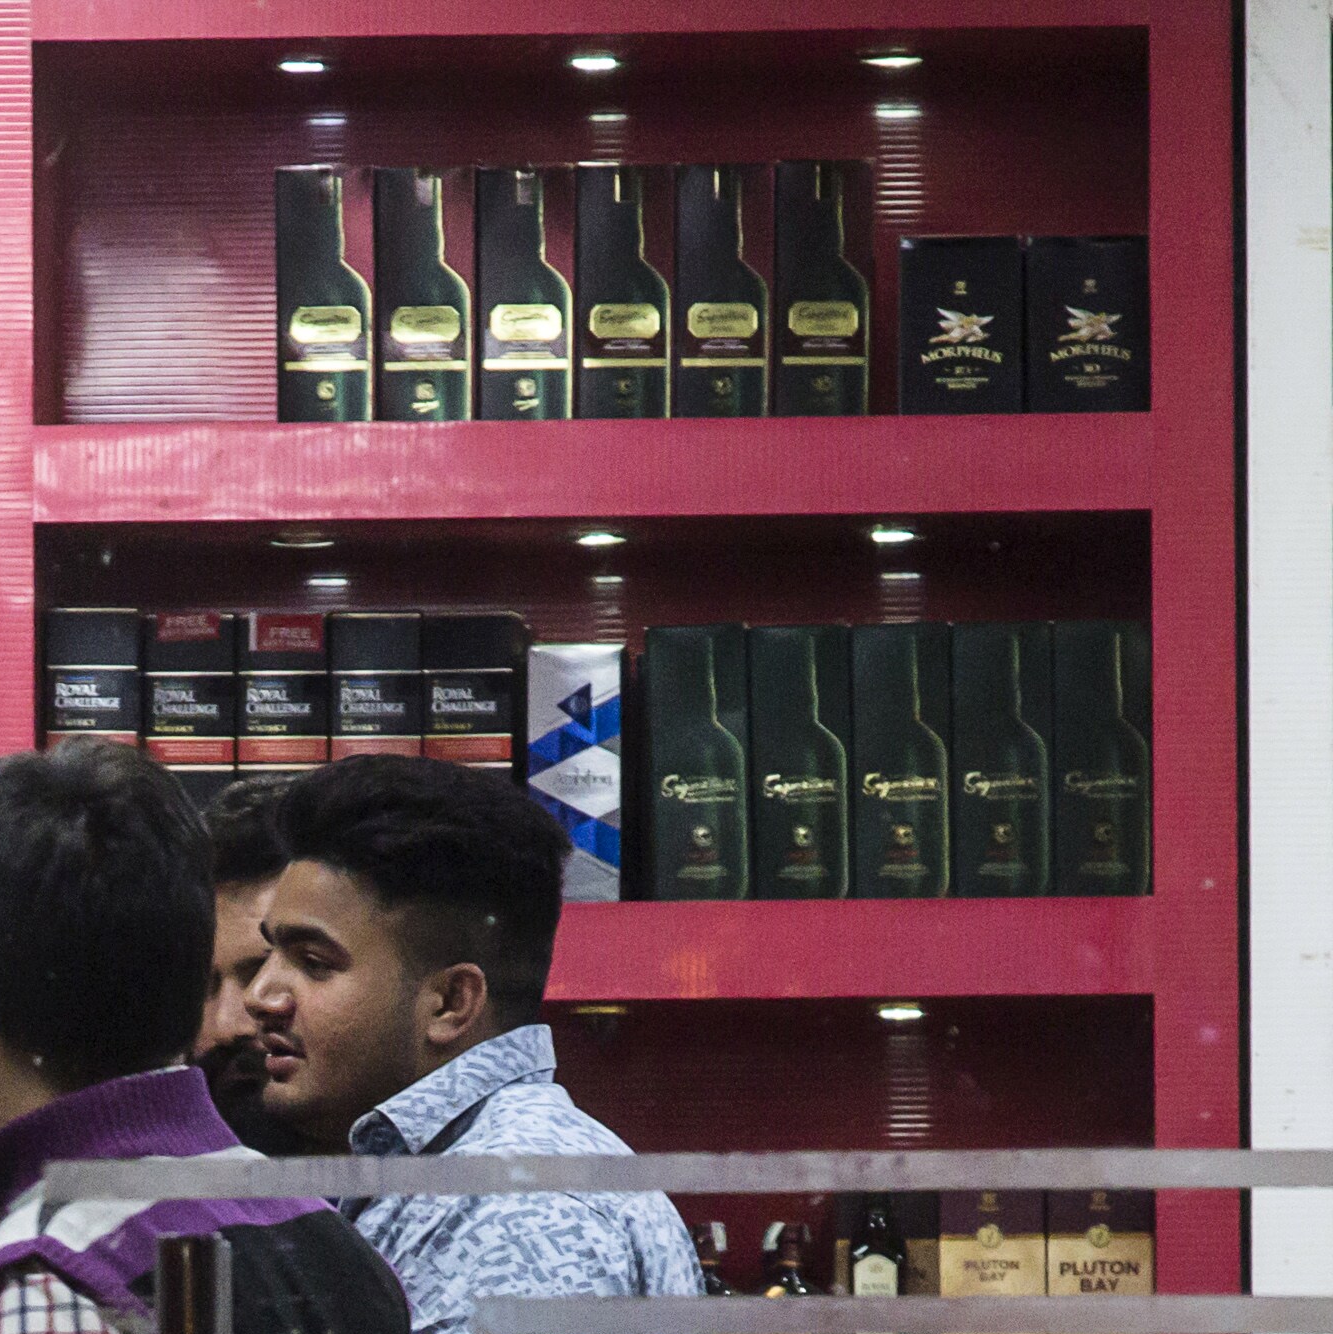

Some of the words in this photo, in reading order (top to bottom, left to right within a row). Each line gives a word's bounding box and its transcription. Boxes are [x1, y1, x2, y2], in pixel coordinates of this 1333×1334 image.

[268, 626, 312, 639] FREE
[1059, 1260, 1140, 1276] PLUTON
[1080, 1278, 1119, 1293] BAY
